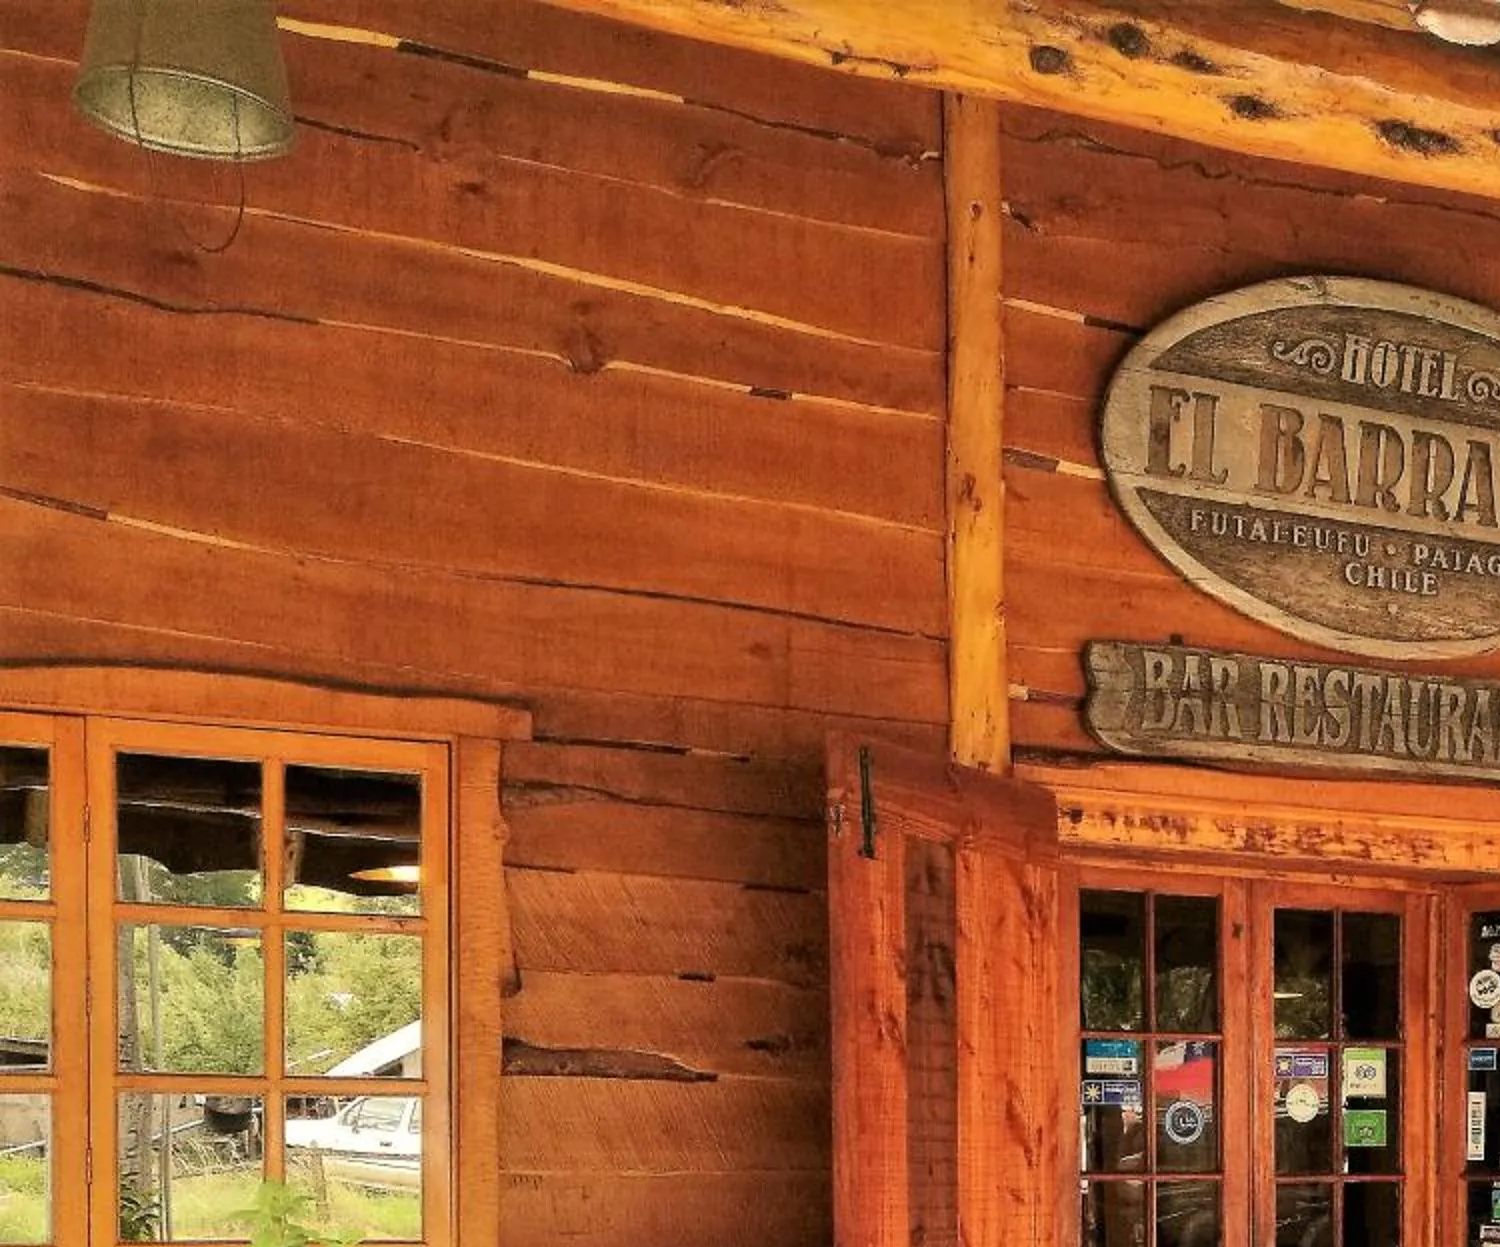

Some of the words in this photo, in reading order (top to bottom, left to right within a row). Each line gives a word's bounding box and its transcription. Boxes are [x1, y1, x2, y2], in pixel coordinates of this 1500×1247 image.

[1340, 332, 1463, 402] HOTEL
[1143, 384, 1229, 487] EL
[1190, 508, 1372, 558] FUTALEUFU
[1344, 562, 1439, 597] CHILE
[1140, 652, 1242, 740] BAR
